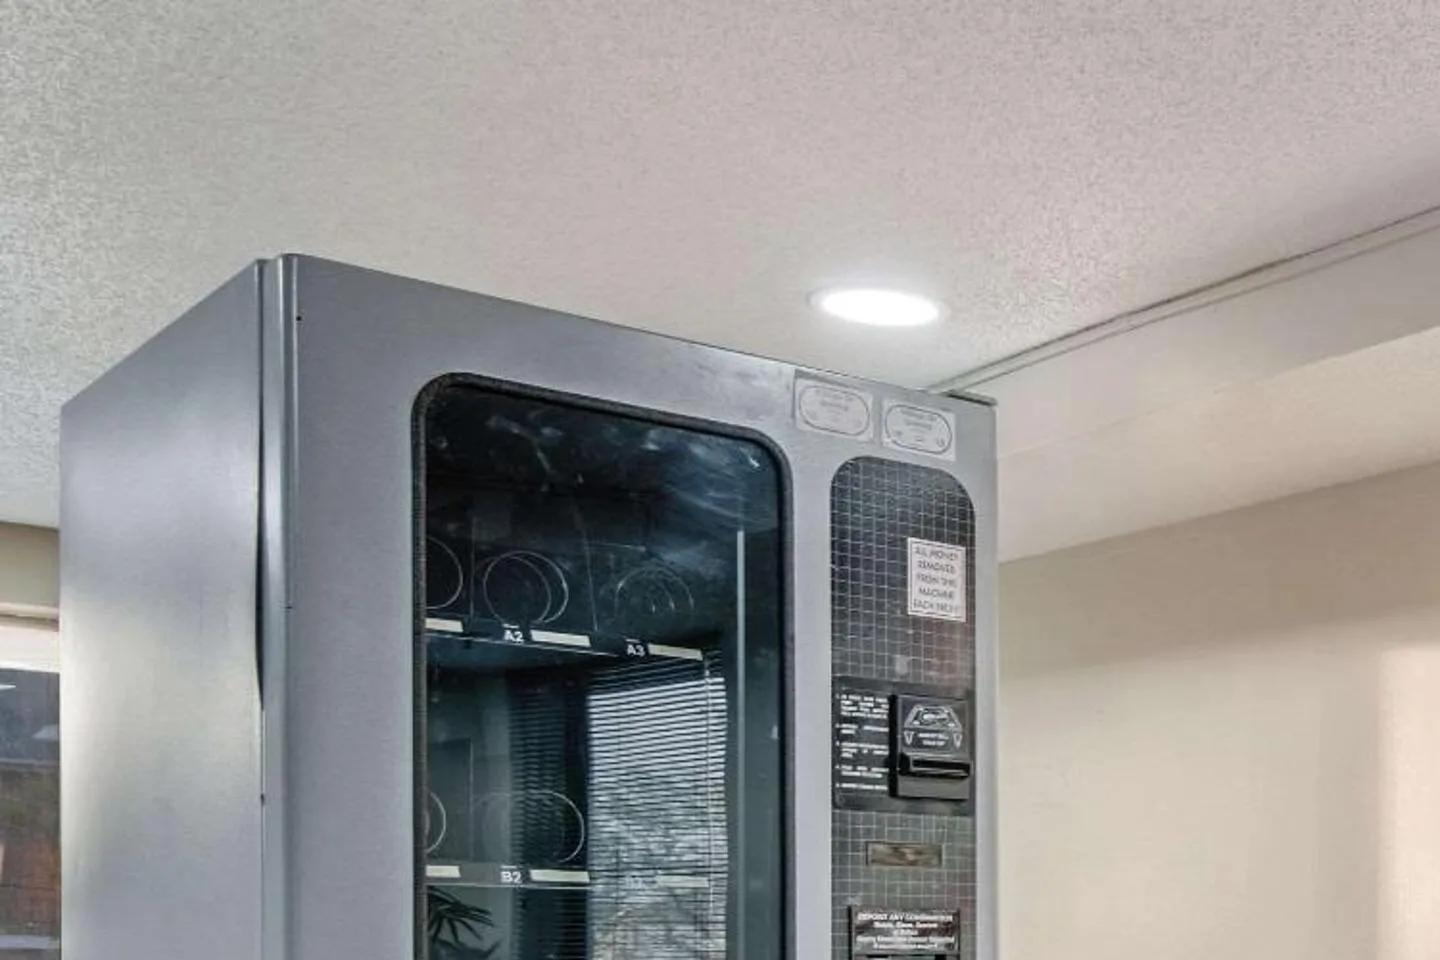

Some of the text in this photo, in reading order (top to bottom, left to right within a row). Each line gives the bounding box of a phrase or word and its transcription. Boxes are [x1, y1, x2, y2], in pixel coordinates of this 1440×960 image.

[504, 630, 524, 643] A2
[626, 644, 645, 657] A3
[501, 871, 522, 884] B2
